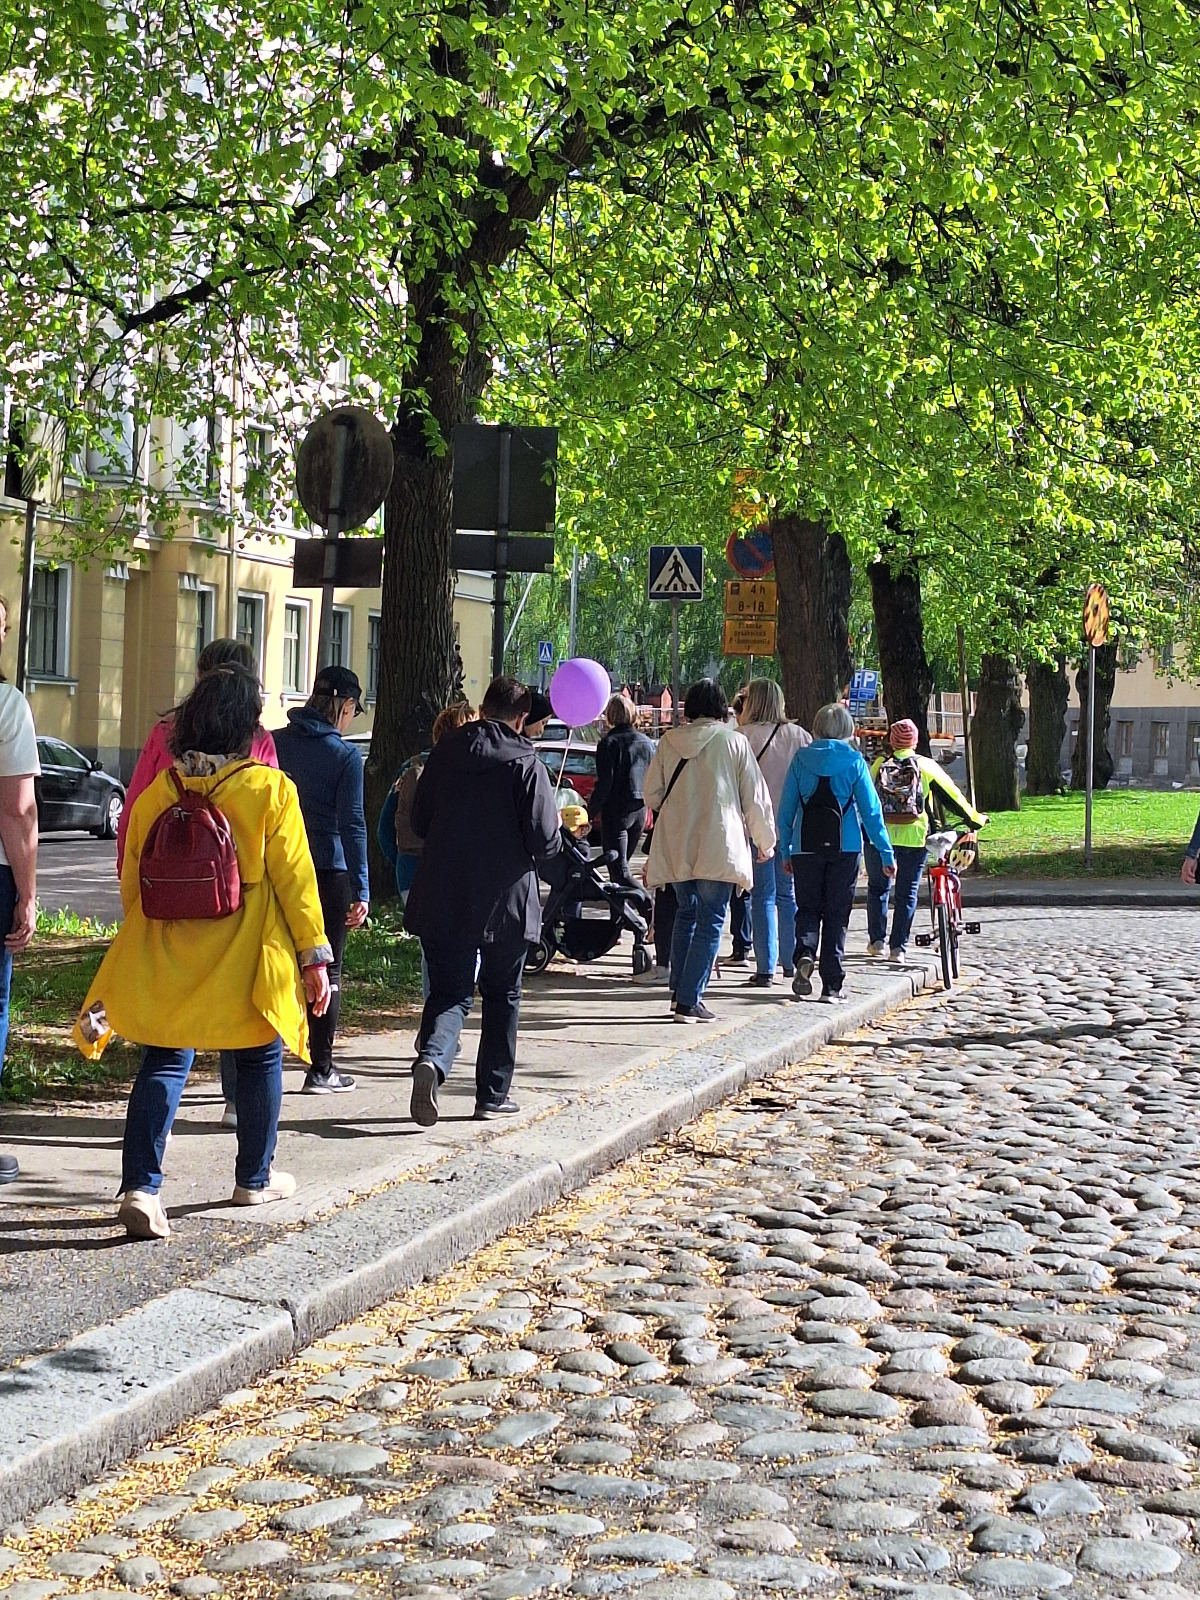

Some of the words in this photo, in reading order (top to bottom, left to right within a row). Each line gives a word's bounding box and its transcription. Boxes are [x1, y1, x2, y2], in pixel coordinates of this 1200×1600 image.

[750, 583, 756, 593] 4
[760, 585, 765, 594] h
[738, 601, 764, 612] 8-18
[863, 672, 875, 687] P
